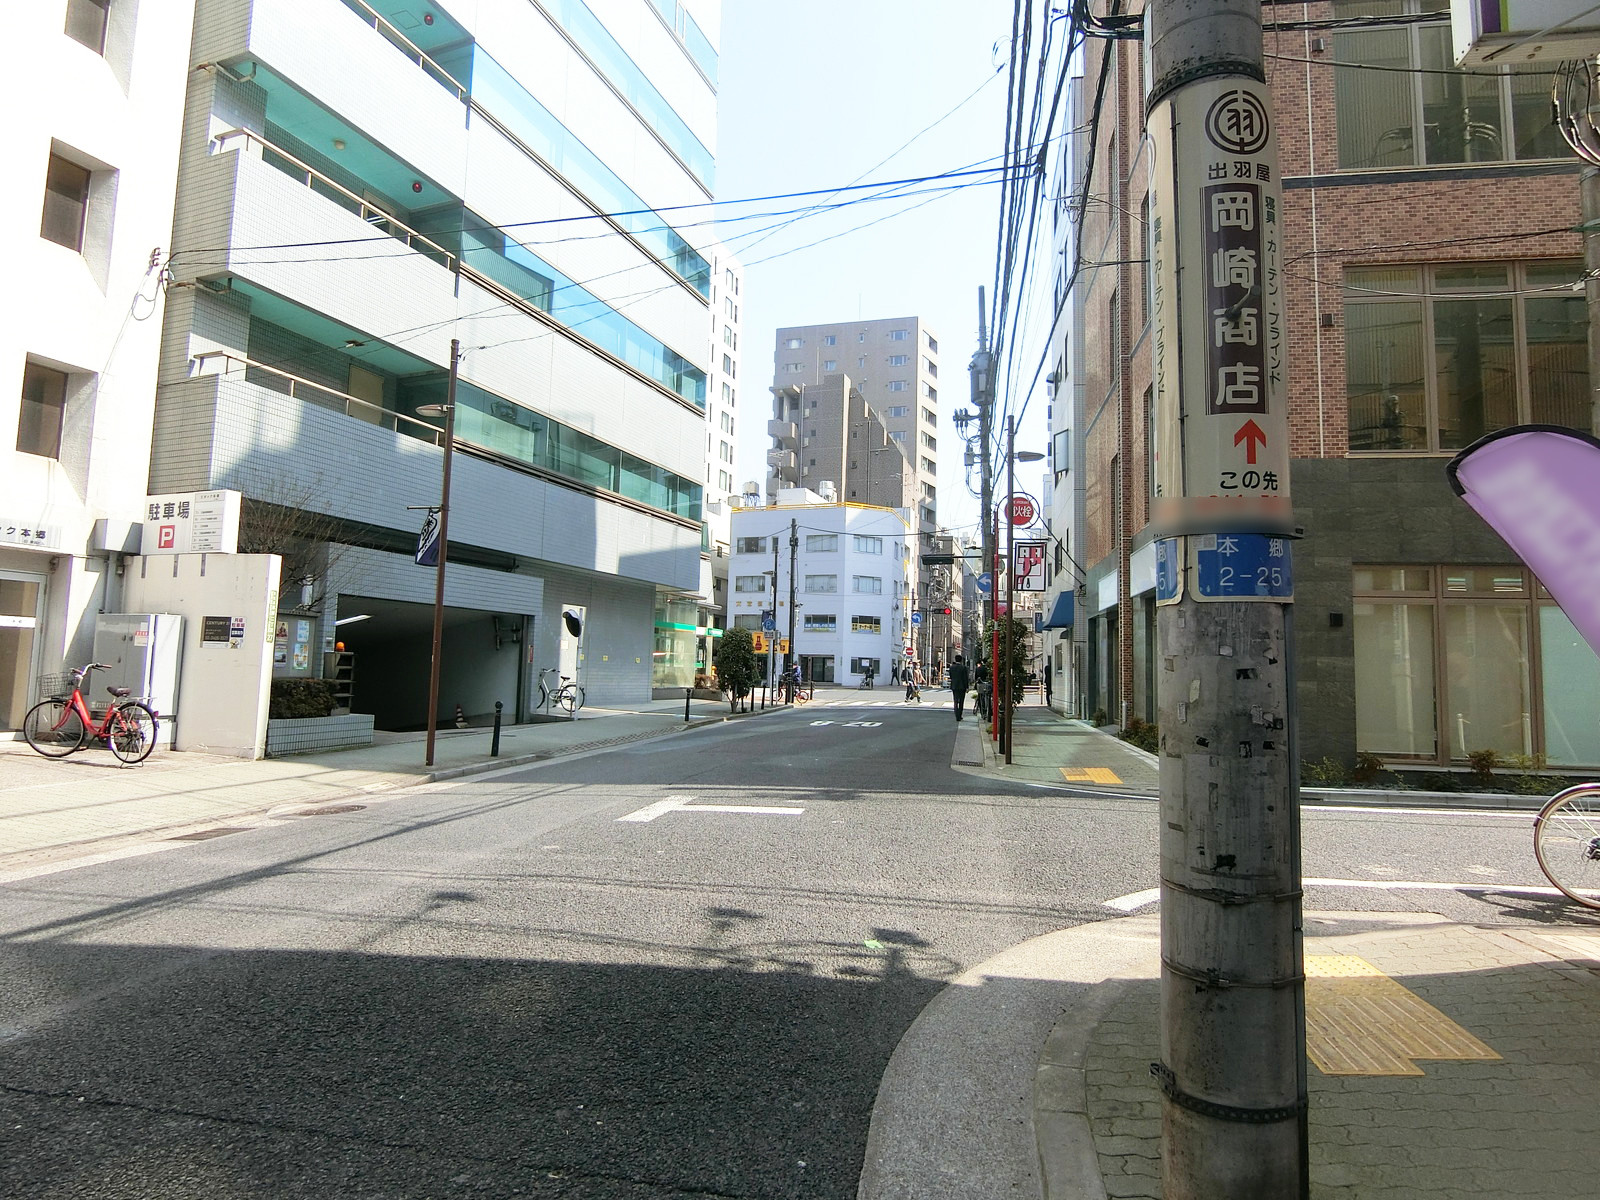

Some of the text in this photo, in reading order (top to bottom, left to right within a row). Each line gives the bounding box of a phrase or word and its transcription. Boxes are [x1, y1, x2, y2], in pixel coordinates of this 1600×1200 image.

[1207, 160, 1271, 183] 出羽屋
[1211, 191, 1260, 406] 岡崎商店
[1219, 470, 1279, 491] この先
[148, 501, 190, 521] 駐車場
[1013, 505, 1032, 518] 火栓
[0, 526, 46, 540] ク本郷
[160, 527, 174, 547] P
[1216, 536, 1284, 559] 本郷
[1219, 566, 1282, 587] 2-25
